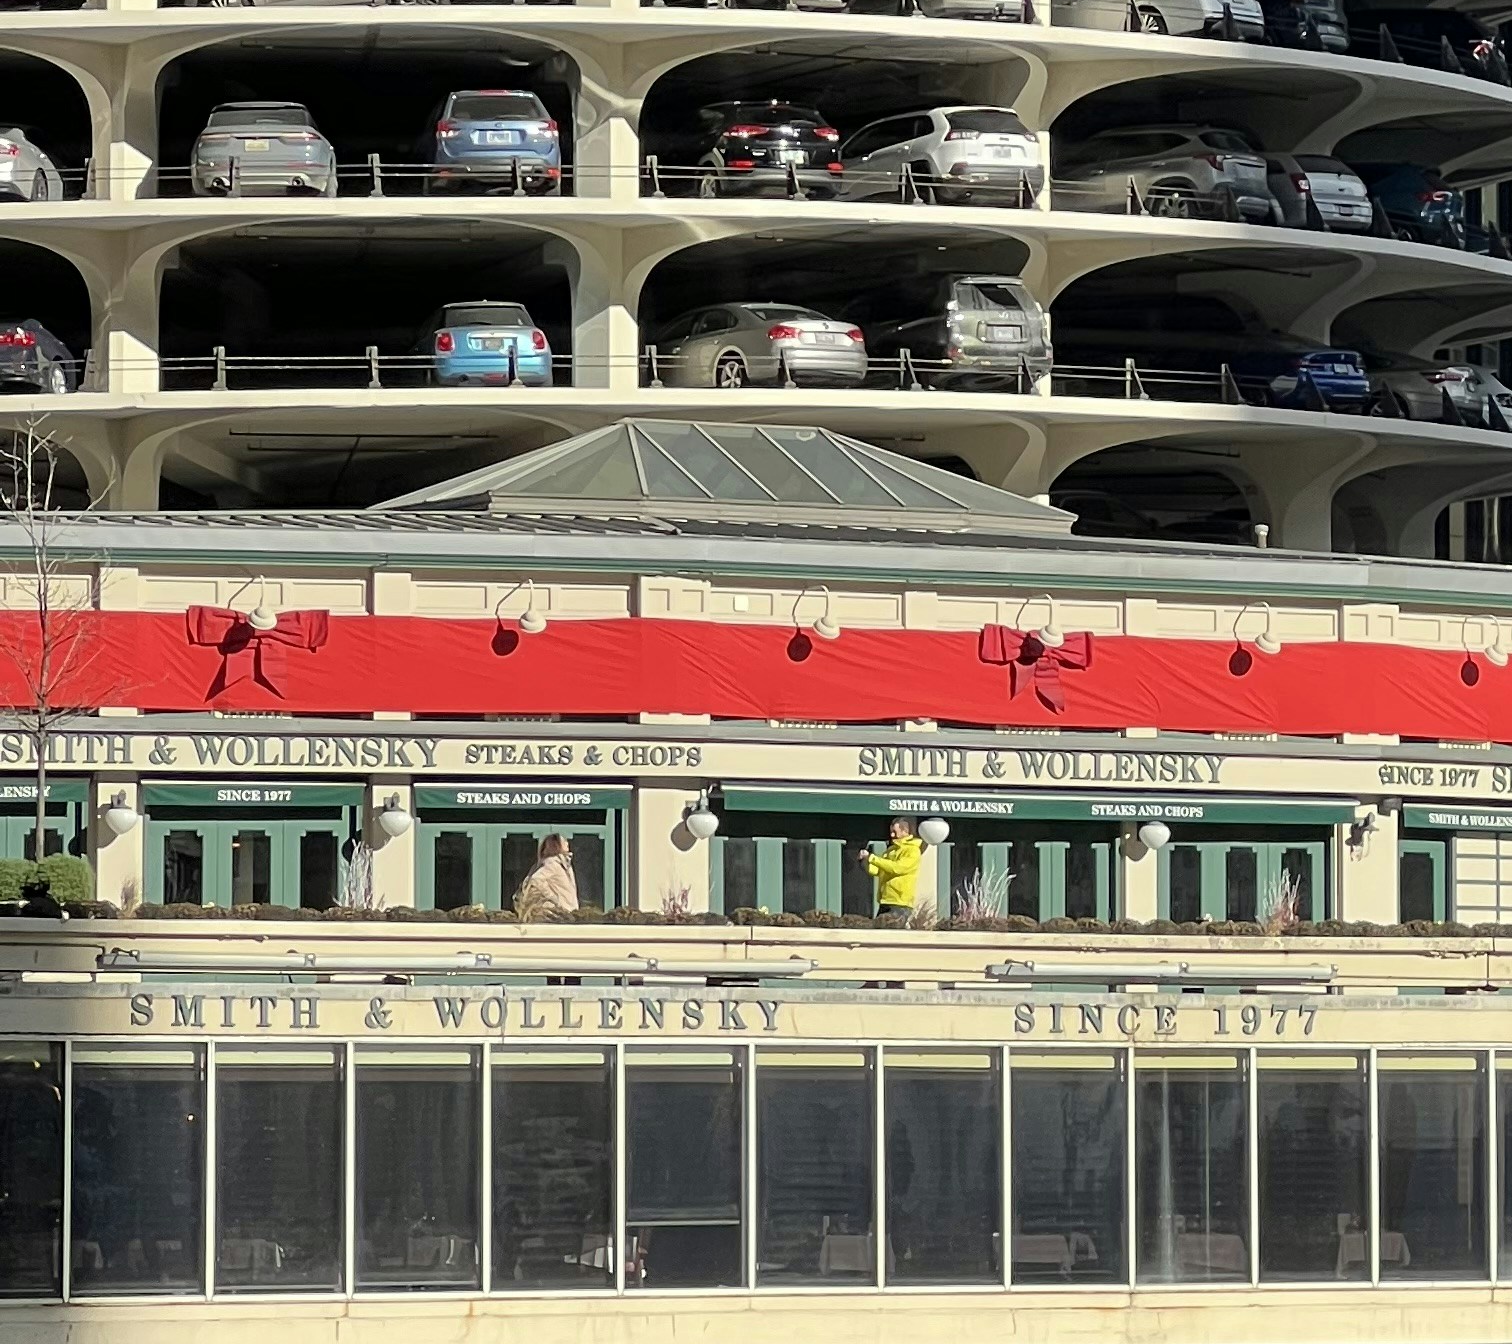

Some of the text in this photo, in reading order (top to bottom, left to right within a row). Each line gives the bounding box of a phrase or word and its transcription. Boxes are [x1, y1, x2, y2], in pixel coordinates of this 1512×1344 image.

[0, 733, 702, 769] SMITH & WOLLENSKY STEAKS & CHOPS
[858, 747, 1226, 784] SMITH & WOLLENSKY
[1379, 764, 1434, 786] SINCE
[1440, 767, 1480, 788] 1977
[217, 789, 292, 802] SINCE 1977
[456, 792, 591, 805] STEAKS AND CHOPS
[888, 799, 1014, 814] SMITH & WOLLENSKY
[1091, 803, 1204, 818] STEAKS AND CHOPS
[1428, 812, 1460, 825] SMITH
[1461, 814, 1469, 826] &
[129, 994, 785, 1033] SMITH & WOLLENSKY
[1013, 1002, 1320, 1036] SINCE 1977
